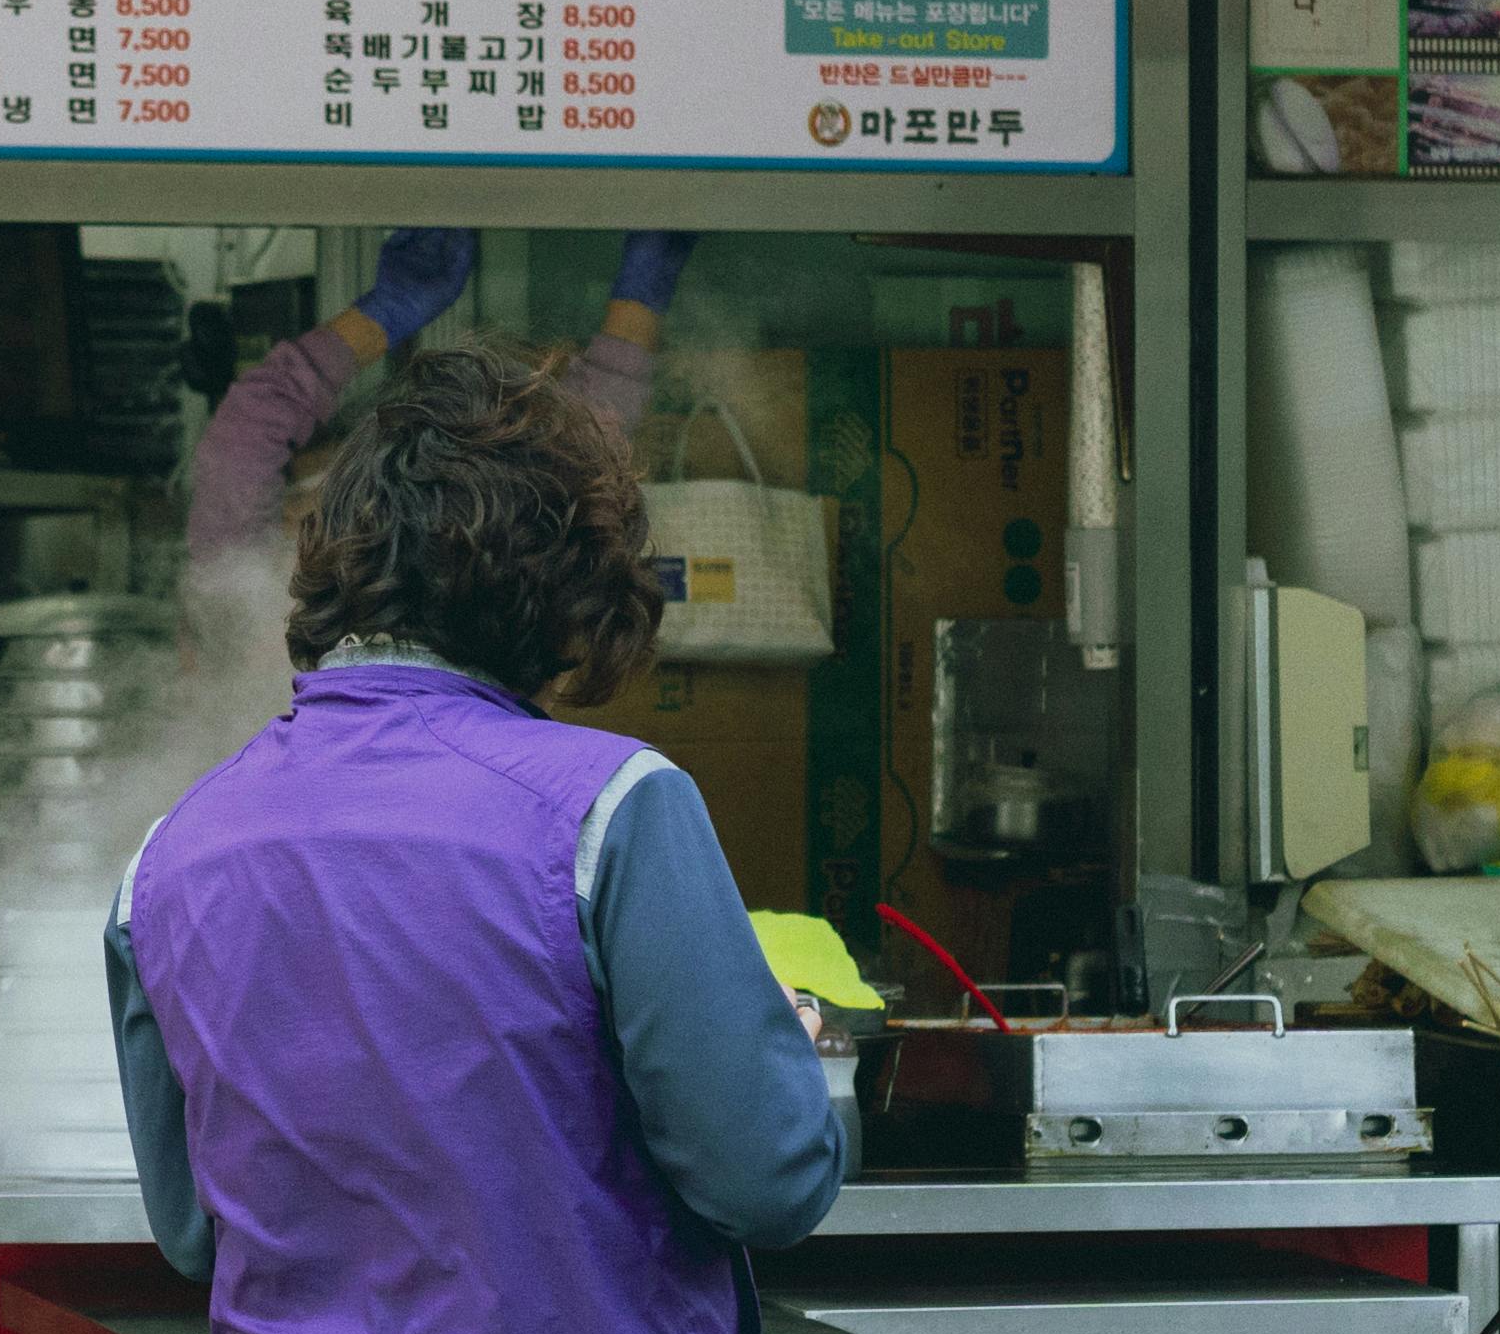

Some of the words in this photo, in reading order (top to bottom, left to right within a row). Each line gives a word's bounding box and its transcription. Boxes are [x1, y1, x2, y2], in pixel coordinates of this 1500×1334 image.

[325, 0, 545, 29] 육개장
[563, 4, 636, 29] 8,500
[854, 0, 917, 24] 메뉴는
[118, 27, 191, 51] 7,500
[325, 33, 544, 62] 뚝배기불고기
[563, 38, 635, 62] 8,500
[946, 29, 1007, 51] Store
[117, 63, 190, 88] 7,500
[324, 67, 544, 96] 순두부찌개
[563, 72, 635, 95] 8,500
[818, 63, 881, 87] 반찬은
[118, 99, 190, 123] 7,500
[325, 102, 545, 131] 비빔밥
[563, 106, 635, 130] 8,500
[861, 107, 1024, 147] 마포만두
